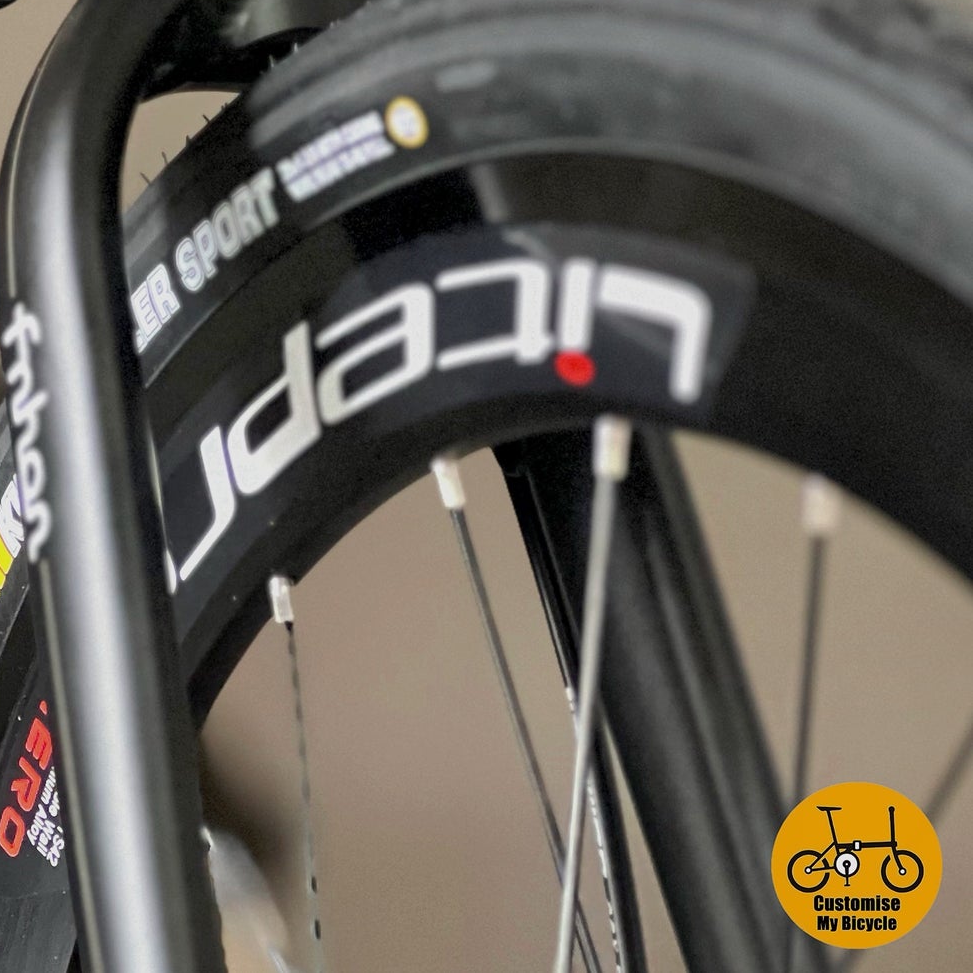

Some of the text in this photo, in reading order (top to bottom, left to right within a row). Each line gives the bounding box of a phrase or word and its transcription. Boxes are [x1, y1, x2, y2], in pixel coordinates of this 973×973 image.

[130, 167, 278, 354] ER SPORT
[163, 257, 713, 595] Litepr
[27, 803, 48, 846] Alloy
